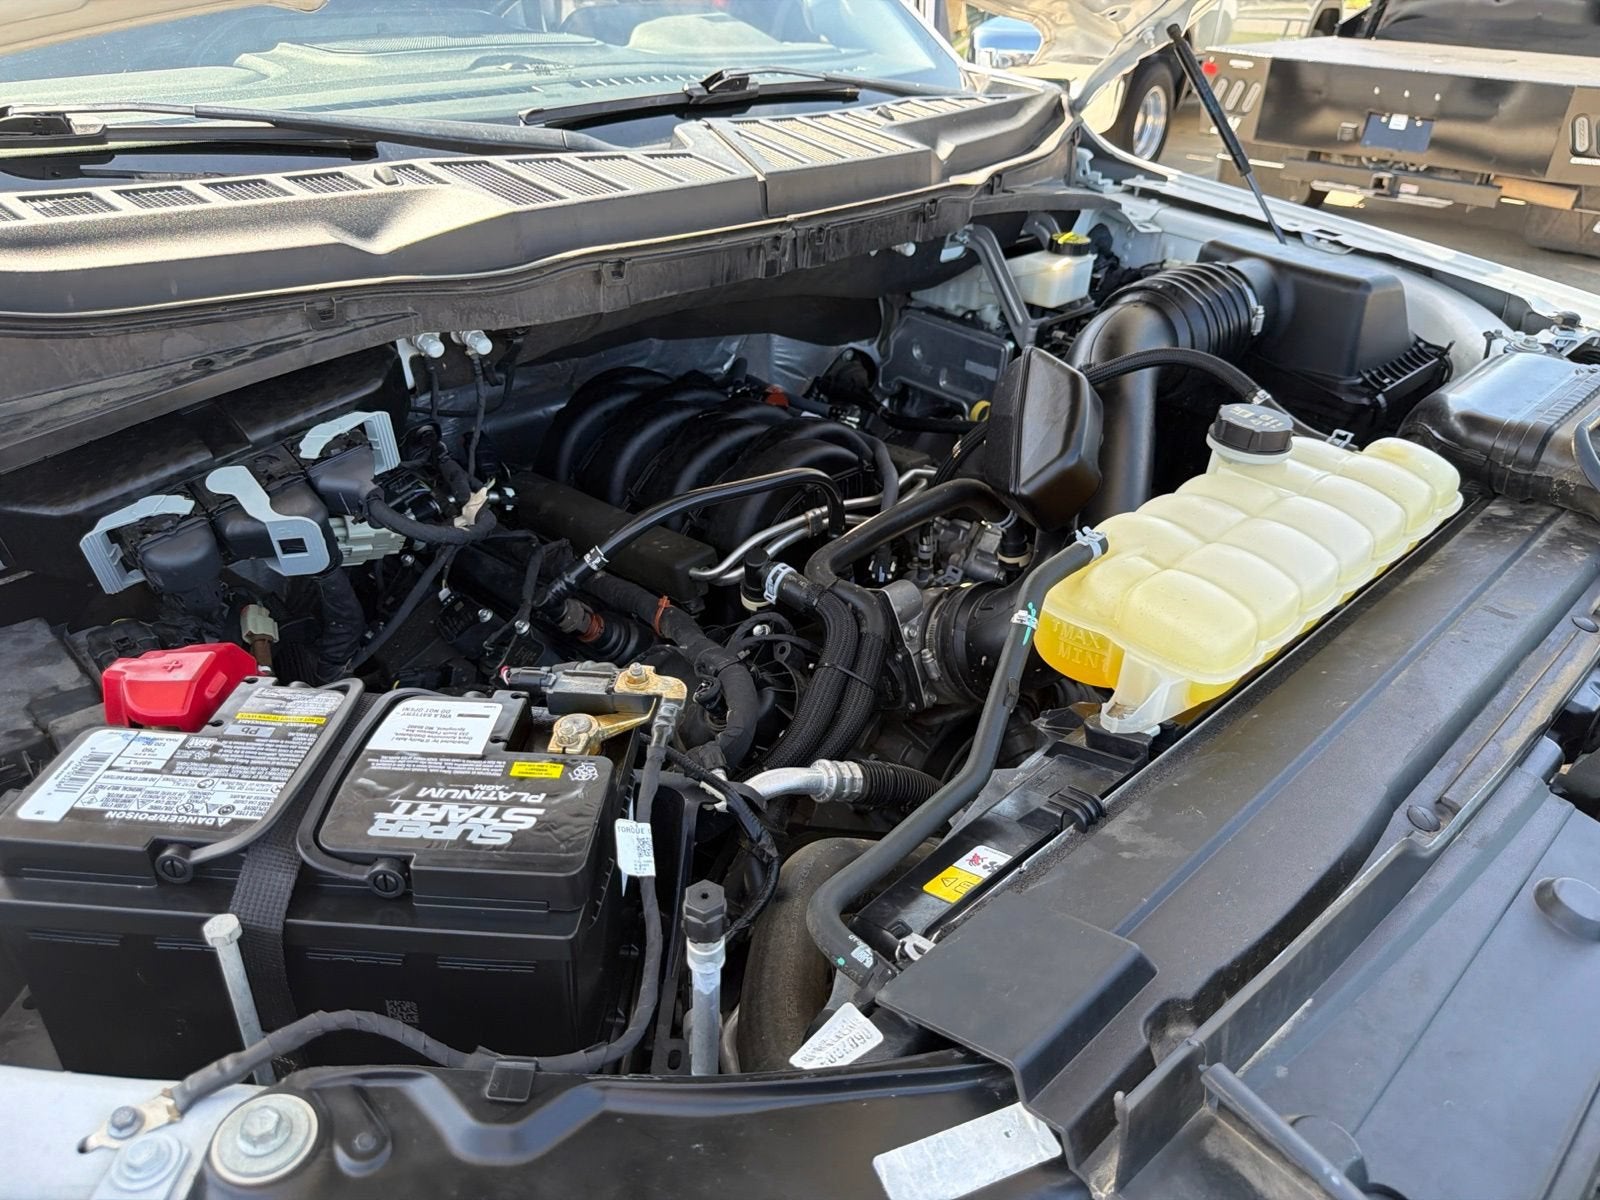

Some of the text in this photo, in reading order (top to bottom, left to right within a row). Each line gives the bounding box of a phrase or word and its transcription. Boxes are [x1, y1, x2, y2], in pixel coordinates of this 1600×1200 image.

[1060, 625, 1101, 649] MAX
[1058, 645, 1098, 668] MIN
[241, 727, 260, 735] Pb
[416, 787, 547, 803] PLATINUM
[105, 810, 215, 826] DANGER/POISON
[373, 802, 545, 829] START
[367, 816, 517, 845] SUPER
